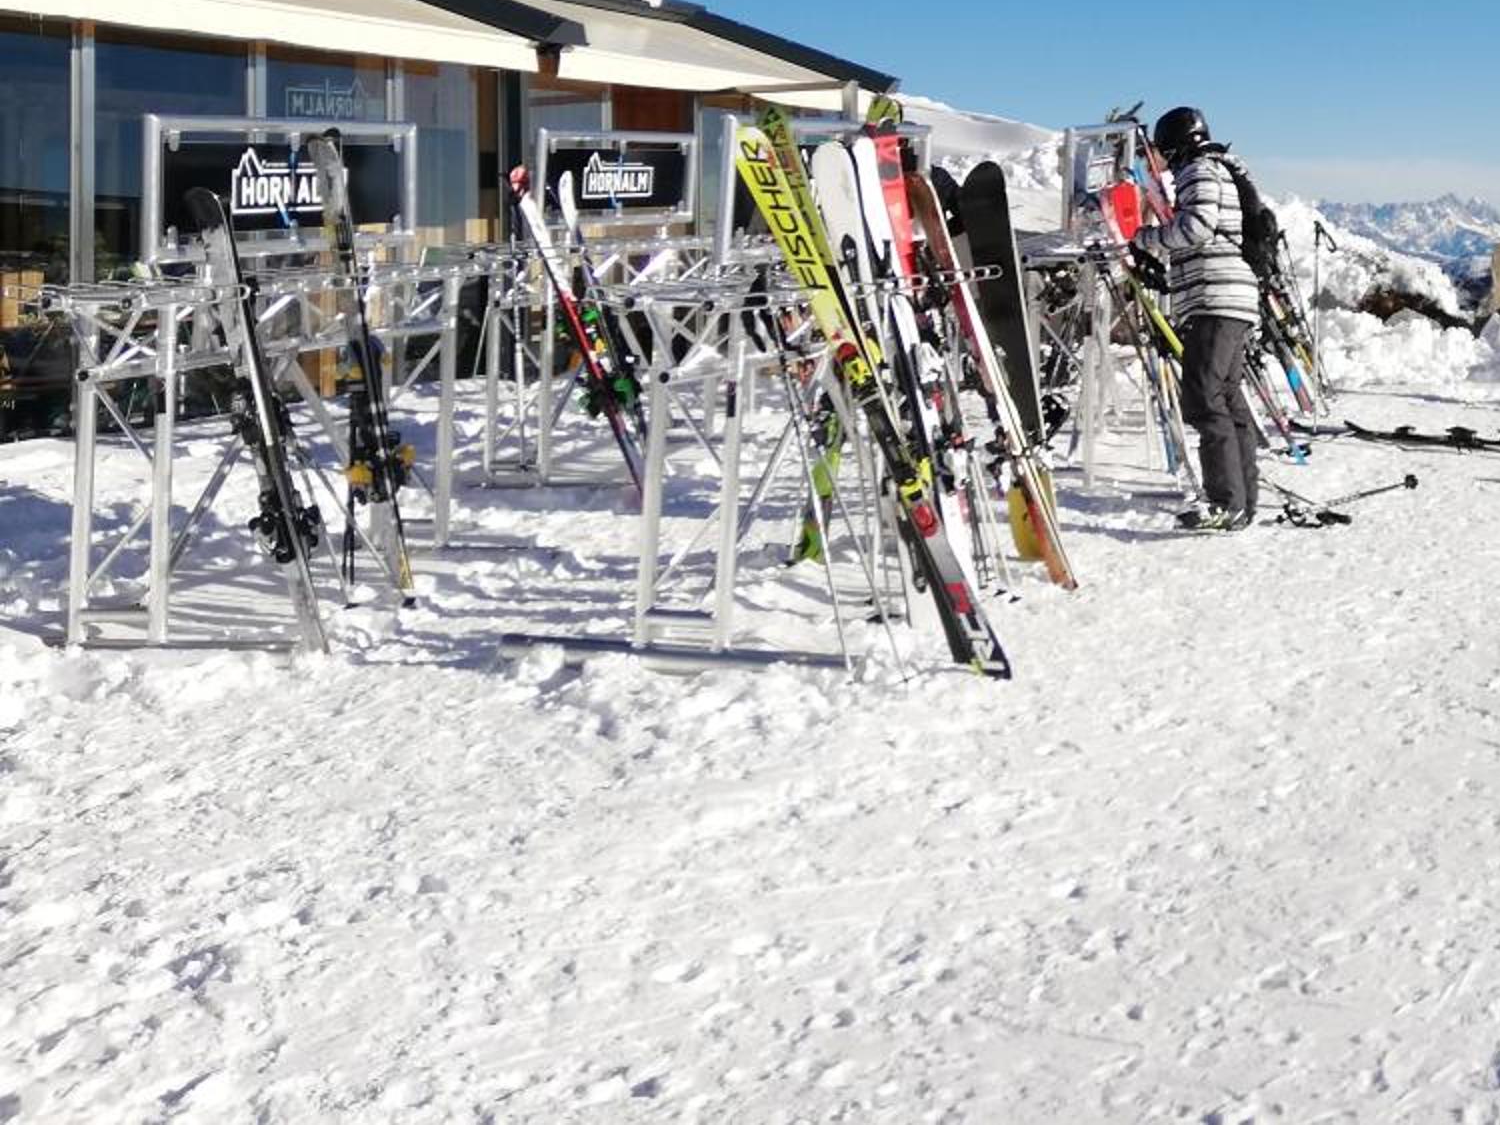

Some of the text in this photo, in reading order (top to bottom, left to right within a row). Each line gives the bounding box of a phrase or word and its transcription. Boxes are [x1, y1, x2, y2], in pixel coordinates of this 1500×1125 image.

[241, 176, 324, 206] HORNAL
[588, 172, 649, 193] HORNALM
[741, 140, 829, 290] FISCHER
